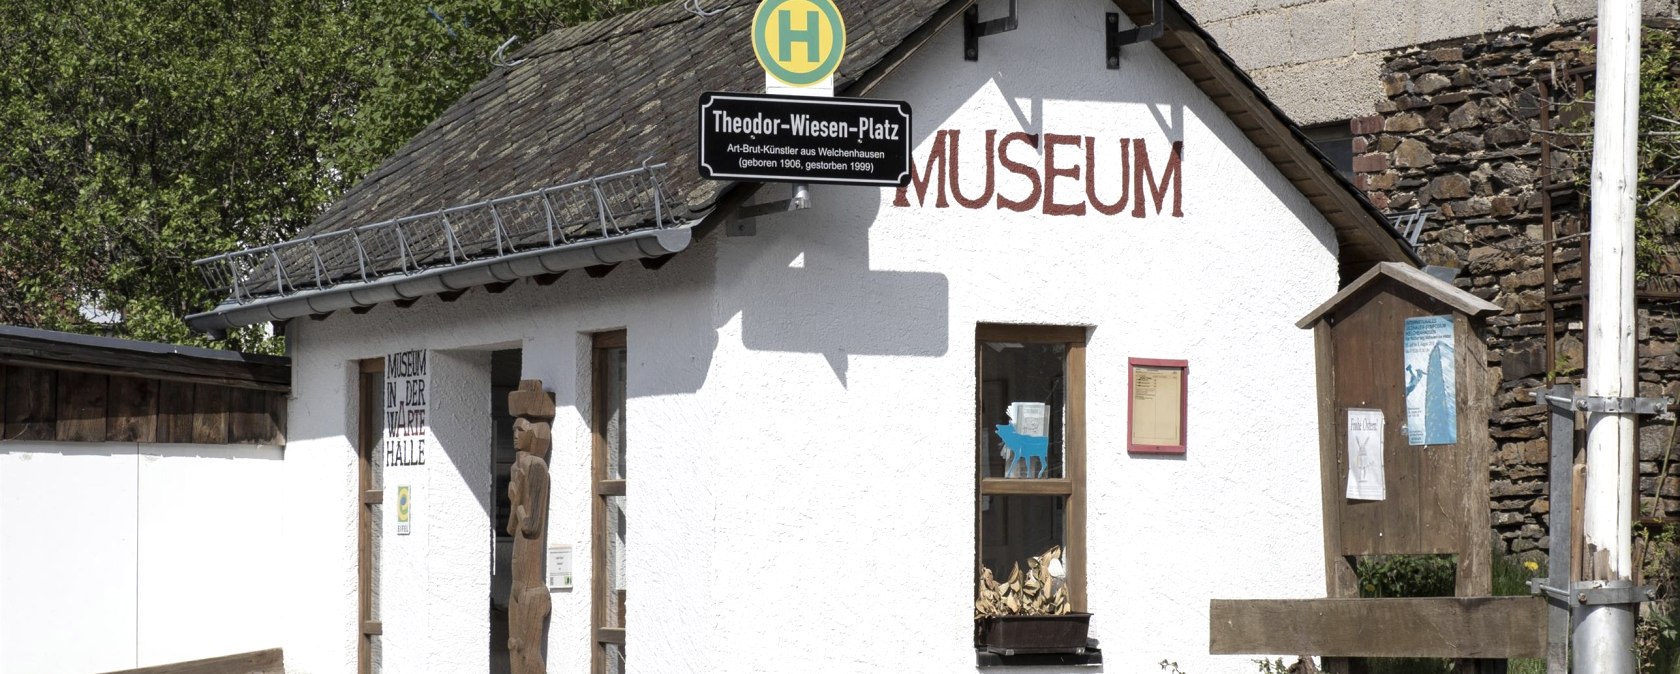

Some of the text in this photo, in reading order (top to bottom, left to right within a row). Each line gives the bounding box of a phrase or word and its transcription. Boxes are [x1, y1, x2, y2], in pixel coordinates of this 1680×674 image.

[779, 10, 820, 62] H
[713, 110, 899, 141] Theodor-Wiesen-Platz
[726, 143, 886, 160] Art-Brut-Künstler aus Welchenhausen
[738, 157, 777, 168] (geboren
[805, 161, 848, 172] gestorben
[850, 162, 875, 174] 1999)
[892, 128, 1185, 219] MUSEUM
[387, 349, 427, 379] MUSEUM
[387, 379, 426, 408] IN DER
[387, 400, 426, 438] WARTE
[386, 439, 425, 466] HALLE
